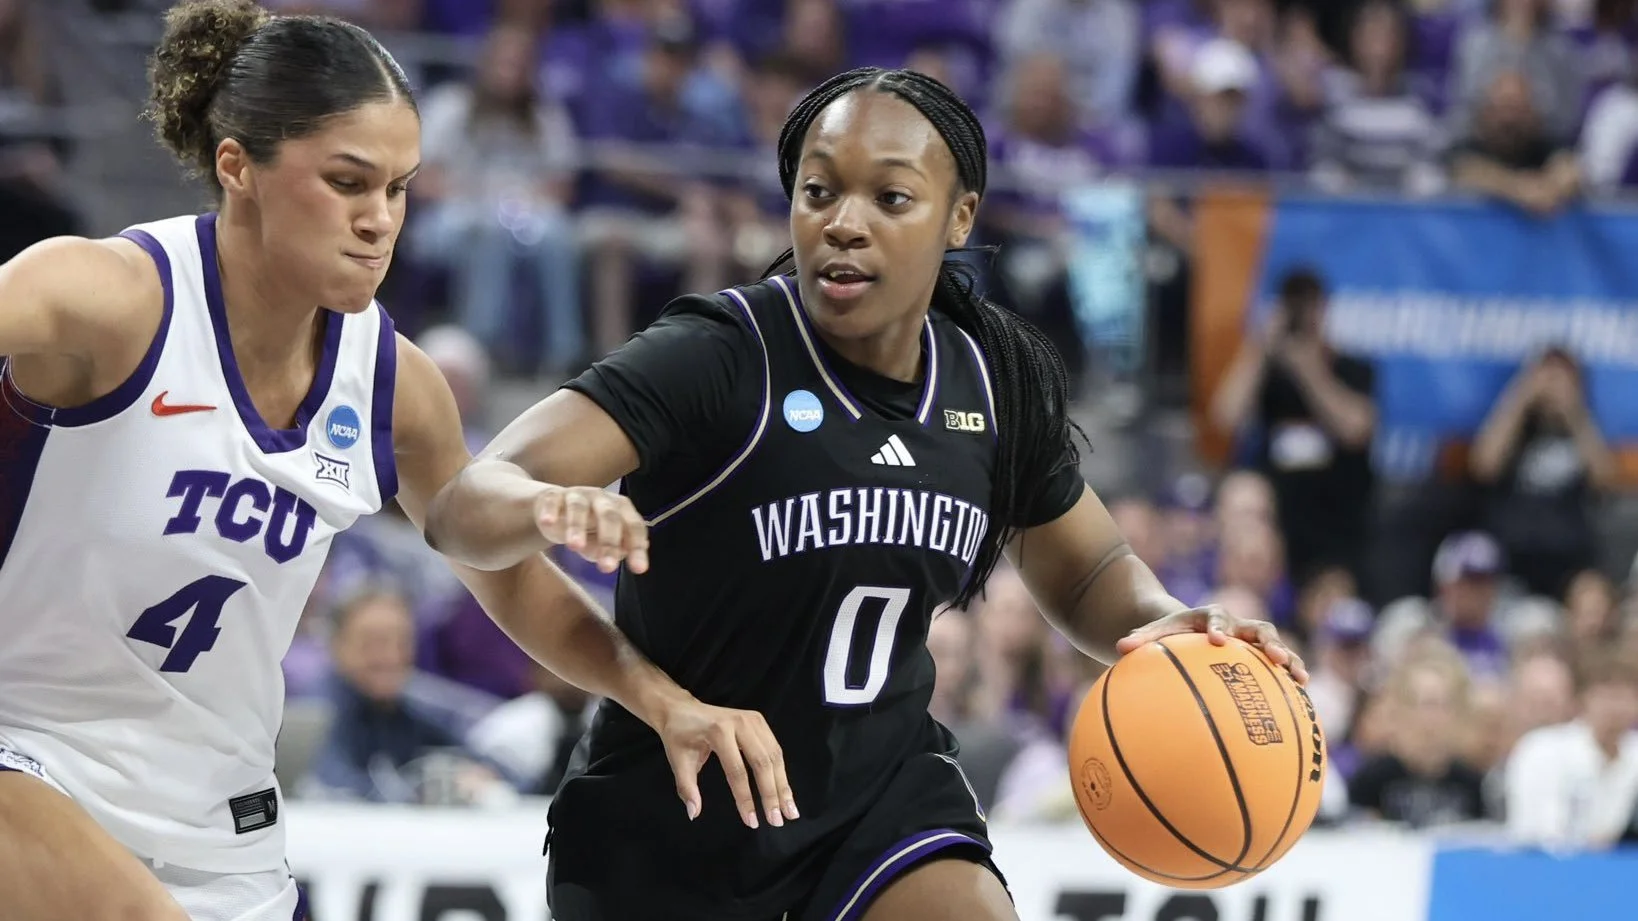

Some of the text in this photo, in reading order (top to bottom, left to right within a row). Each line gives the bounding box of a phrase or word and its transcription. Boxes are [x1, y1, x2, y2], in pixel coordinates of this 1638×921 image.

[330, 423, 358, 440] NCAA
[789, 409, 822, 421] NCAA
[162, 469, 317, 564] TCU
[126, 574, 248, 673] 4
[822, 585, 911, 706] 0
[1227, 680, 1269, 745] MADNESS
[1234, 673, 1274, 720] MARCH
[1293, 683, 1321, 782] son
